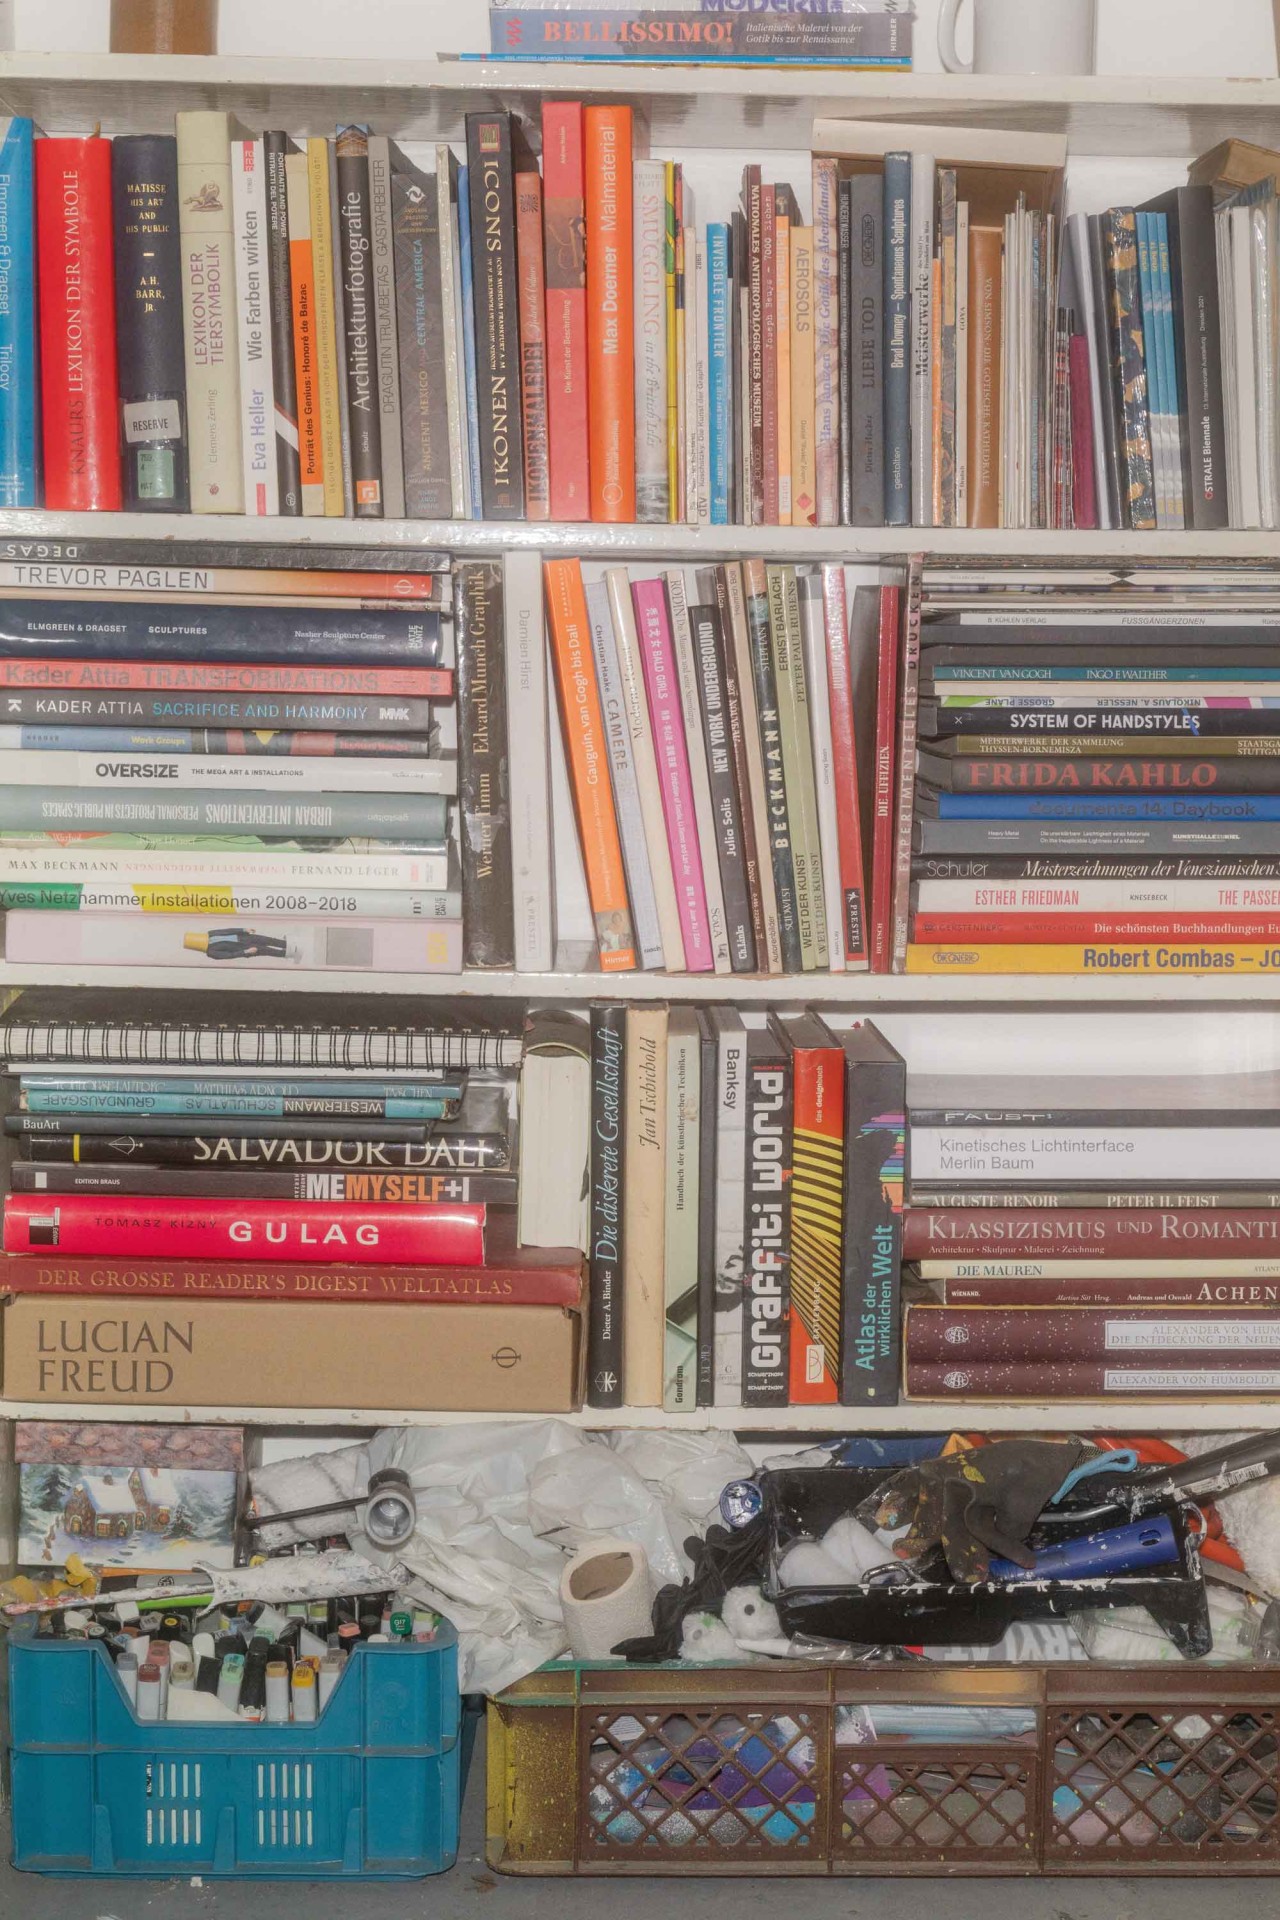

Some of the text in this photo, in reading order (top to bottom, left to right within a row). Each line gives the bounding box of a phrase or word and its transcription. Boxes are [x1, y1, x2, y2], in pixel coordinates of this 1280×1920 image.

[543, 21, 734, 44] BELLISSIMO!
[745, 22, 829, 34] Italienische Malerei
[745, 34, 856, 45] Gotik Renaissance
[484, 160, 503, 251] ICONS
[599, 126, 619, 356] Max Doerner Malmaterial
[641, 194, 660, 335] SMUGGLING
[711, 234, 726, 295] INVISIBLE
[62, 169, 84, 393] LEXIKON DER SYMBOLE
[242, 210, 263, 362] Wie Farben wirken
[372, 159, 396, 414] DRAGUTIN TRUMBETAS GASTARBEITER
[795, 246, 811, 332] AEROSOLS
[189, 253, 209, 366] LEXIKON DER
[205, 243, 224, 366] TIERSYMBOLIK
[342, 191, 373, 412] Architekturfotografie
[751, 184, 763, 428] NATIONALES ANTHROPOLOGISCHES MUSEUM
[712, 299, 726, 358] FRONTIER
[915, 273, 931, 377] Meisterwerke
[861, 297, 876, 389] LIEBE TOD
[889, 198, 908, 491] gestalten Spontaneous Sculptures
[298, 283, 317, 475] Porträt des Genius: Honoré de Balzac
[132, 417, 169, 432] RESERVE
[249, 389, 267, 471] Eva Heller
[491, 375, 510, 486] IKONEN
[13, 566, 208, 590] TREVOR PAGLEN
[771, 576, 786, 632] BARLACH
[27, 622, 208, 636] ELMGREEN DRAGSET SCULPTURES
[1121, 615, 1206, 626] FUSSGÄNGERZONEN
[294, 630, 360, 641] Nasher Sculpture
[80, 665, 131, 685] Attia
[952, 668, 1168, 681] VINCENT GOGH INGO WALTHER
[36, 699, 369, 720] KADER ATTIA SACRIFICE AND HARMONY
[698, 621, 729, 774] NEW YORK UNDERGROUND
[1020, 698, 1055, 707] GROSSE
[1096, 698, 1202, 707] NIKOLAUS NESSLER
[467, 569, 493, 879] Werner Edvard Munch Graphik
[606, 698, 629, 771] CAMERE
[1009, 713, 1201, 730] SYSTEM OF HANDSTYLES
[979, 738, 1124, 748] MEISTERWERKE SAMMLUNG
[979, 745, 1082, 755] THYSSEN-BORNEMISZA
[251, 769, 305, 777] INSTALLATIONS
[763, 708, 790, 848] BECKMANN
[968, 762, 1218, 787] FRIDA KAHLO
[205, 803, 333, 827] URBAN INTERVENTIONS
[1172, 802, 1256, 819] Daybook
[8, 859, 353, 876] MAX BECKMANN FERNAND
[926, 859, 1148, 879] Schuler Meisterzeichnungen
[40, 889, 261, 910] Netzhammer Installationen
[974, 889, 1241, 906] ESTHER FRIEDMAN KNESEBECK THE
[1094, 922, 1113, 934] Die
[1114, 922, 1170, 935] schönsten
[1172, 922, 1265, 938] Buchhandlungen
[1083, 948, 1235, 969] Robert Combas
[723, 1048, 741, 1110] Banksy
[42, 1095, 383, 1114] WESTERMANN GRUNDAUSGABE
[637, 1037, 662, 1151] Jan Tschichold
[22, 1119, 60, 1132] BauArt
[939, 1138, 1135, 1154] Kinetisches Lichtinterface
[939, 1155, 1035, 1171] Merlin Baum
[594, 1026, 623, 1341] Dieter Binder Die diskrete Gesellschaft
[676, 1169, 686, 1212] Handbuch
[812, 1065, 825, 1341] BATTENBERG designbuch
[94, 1217, 380, 1246] TOMASZ KIZNY GULAG
[751, 1072, 785, 1369] Graffiti world
[926, 1214, 1106, 1241] KLASSIZISMUS
[928, 1245, 1105, 1257] Architektur Skulptur Malerei Zeichnung
[37, 1269, 514, 1296] DER GROSSE DIGEST WELTATLAS
[956, 1265, 1043, 1278] DIE MAUREN
[871, 1224, 894, 1358] wirklichen Welt
[37, 1319, 195, 1354] LUCIAN
[854, 1283, 877, 1372] Atlas der
[1152, 1325, 1251, 1336] ALEXANDER VON
[37, 1359, 174, 1394] FREUD
[1110, 1375, 1277, 1386] ALEXANDER VON HUMBOLDT
